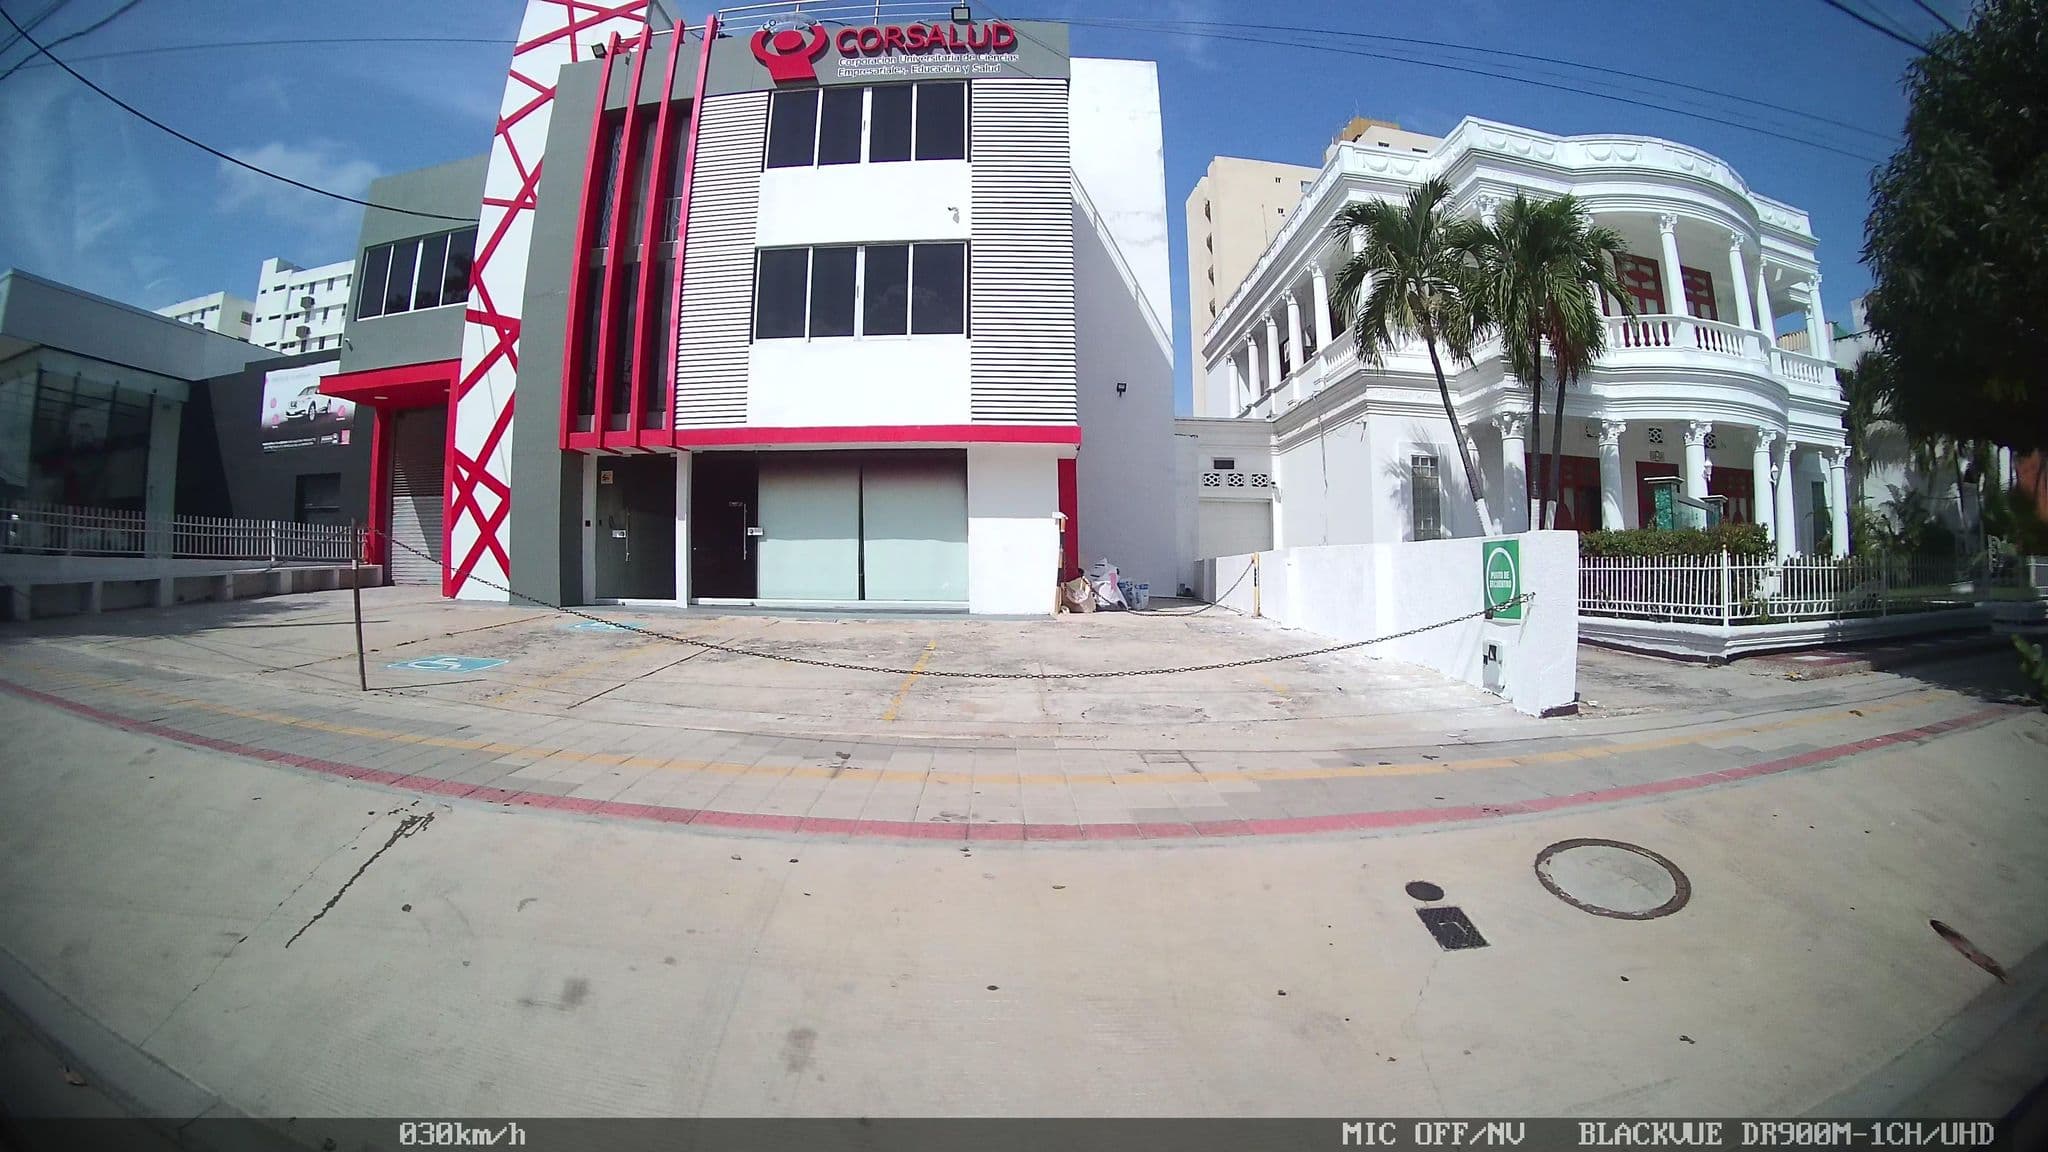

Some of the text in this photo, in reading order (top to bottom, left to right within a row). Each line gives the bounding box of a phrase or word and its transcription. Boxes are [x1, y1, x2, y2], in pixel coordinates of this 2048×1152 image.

[836, 22, 1017, 55] CORSALUD
[899, 53, 960, 63] Universitaria
[961, 53, 976, 61] de
[977, 53, 1019, 62] Ciencias
[962, 64, 970, 74] y
[972, 63, 1001, 73] Salud
